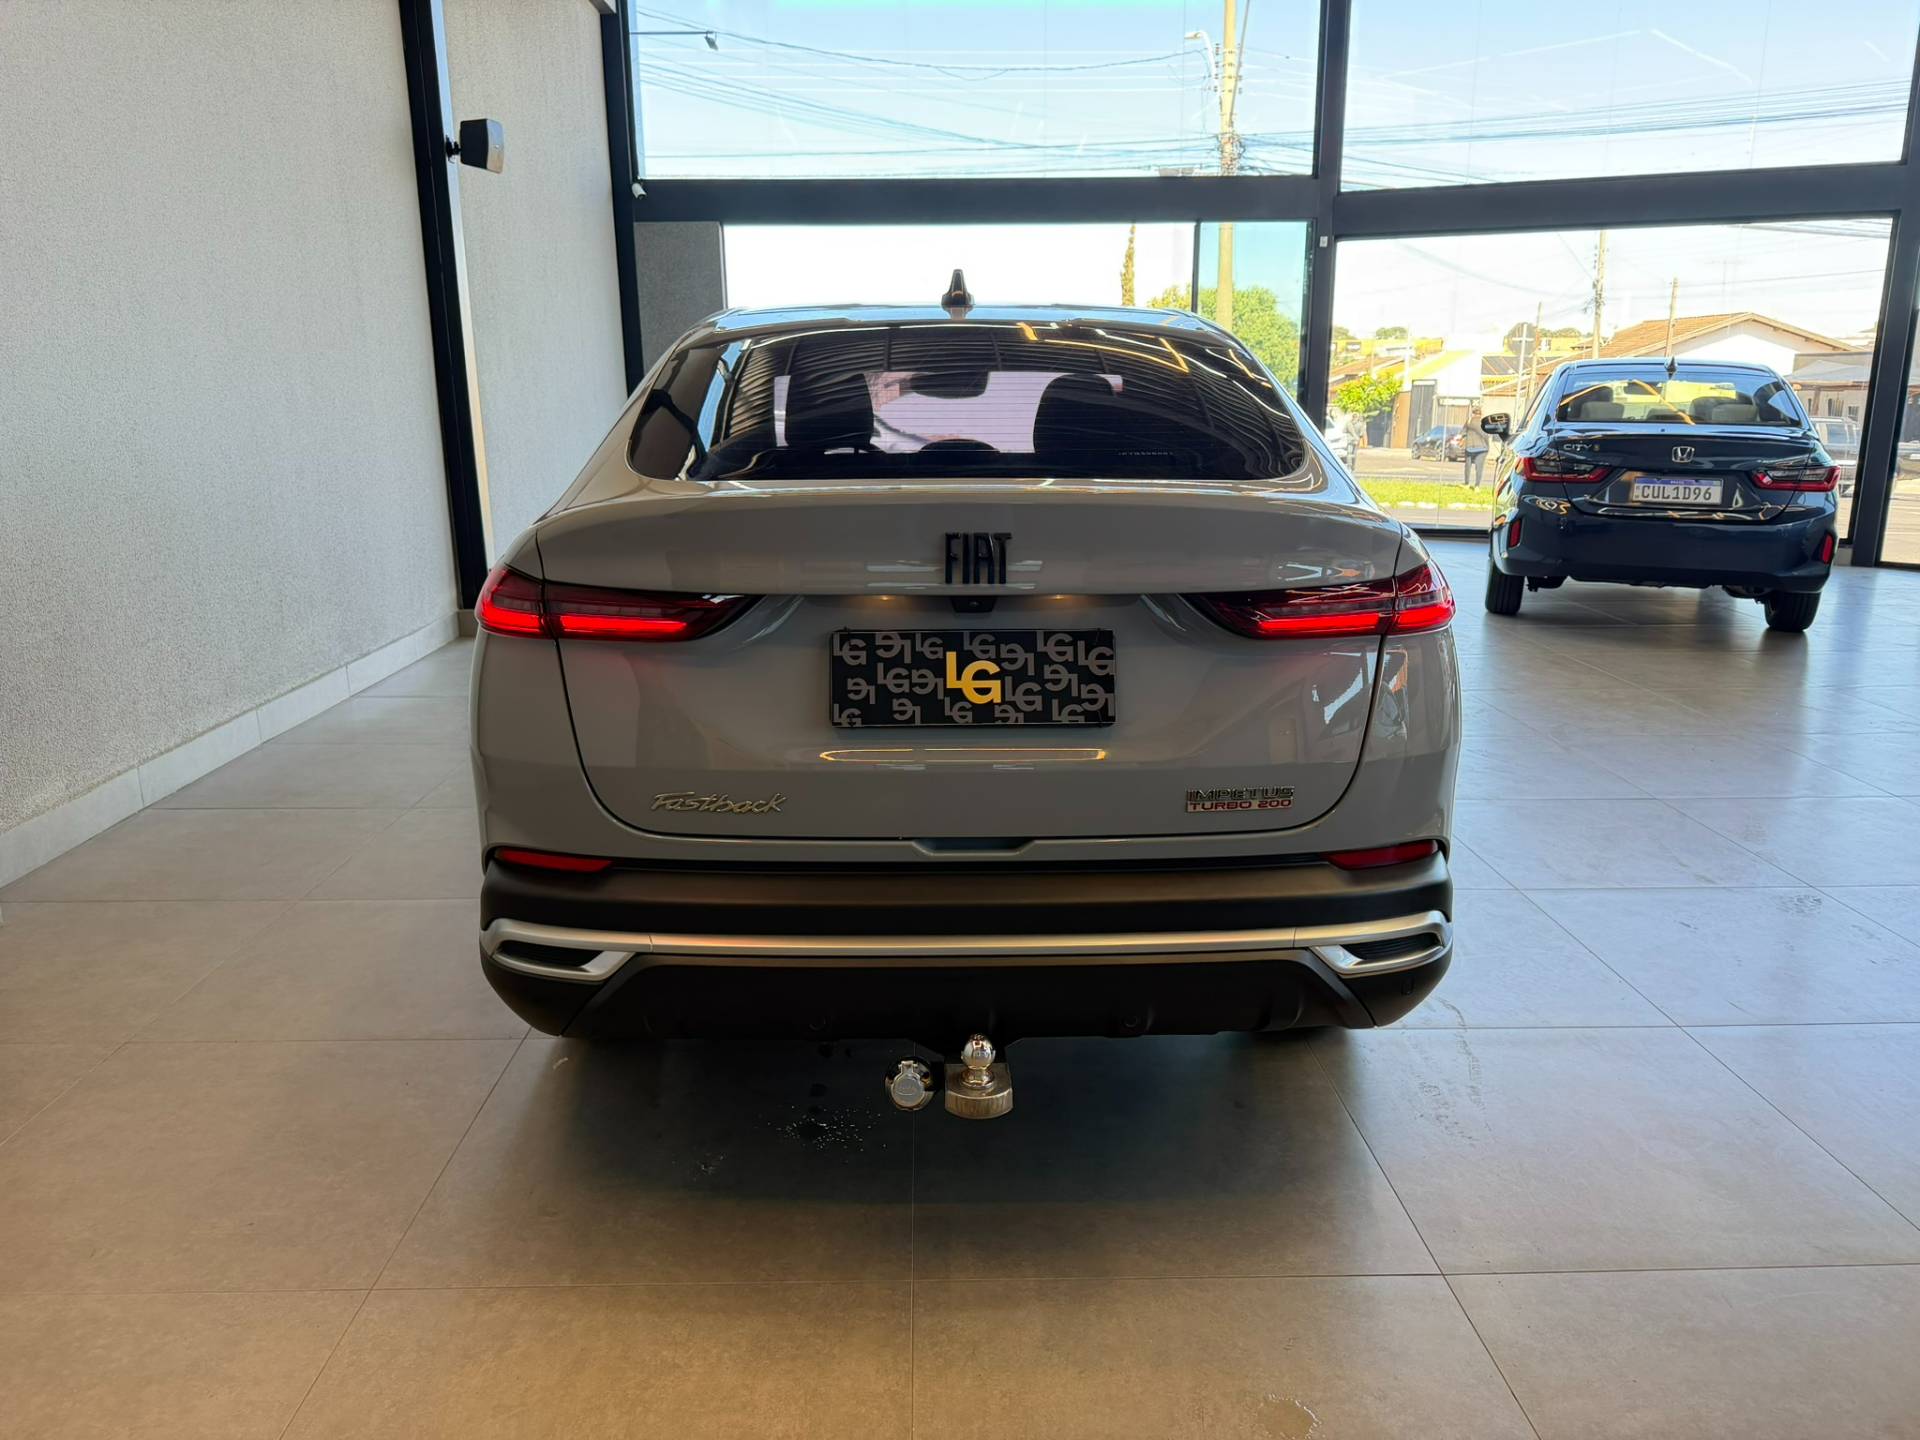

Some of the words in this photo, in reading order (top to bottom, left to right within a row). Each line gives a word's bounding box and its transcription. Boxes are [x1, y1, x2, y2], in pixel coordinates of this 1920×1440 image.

[1563, 443, 1593, 451] CITY
[1641, 485, 1712, 501] CUL1D96
[945, 532, 1012, 585] FIAT
[946, 651, 1001, 704] LG
[1187, 786, 1295, 801] IMPETUS
[651, 791, 787, 814] Fastback
[1190, 801, 1252, 811] TURBO
[1257, 799, 1292, 809] 200
